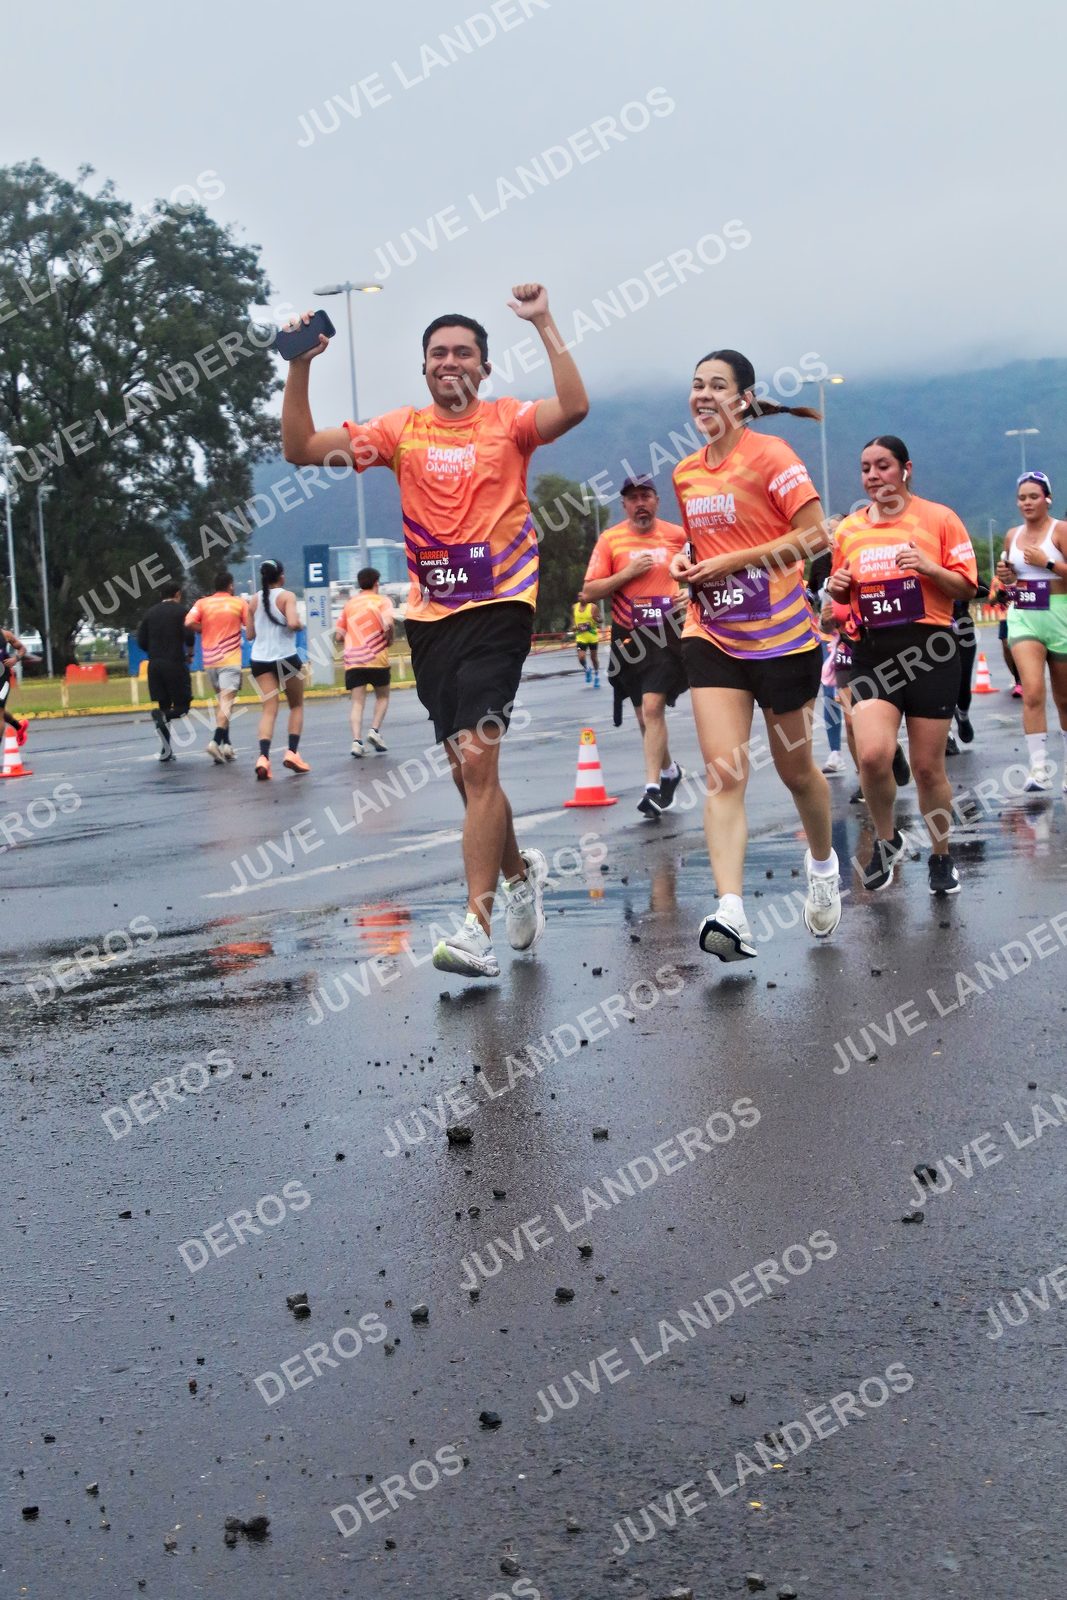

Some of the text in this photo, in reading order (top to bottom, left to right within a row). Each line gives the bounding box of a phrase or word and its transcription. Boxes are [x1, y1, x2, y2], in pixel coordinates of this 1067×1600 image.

[686, 493, 736, 517] CARRERA
[308, 562, 324, 582] E
[434, 568, 468, 585] 344
[713, 588, 744, 606] 345
[642, 608, 662, 618] 798
[872, 598, 902, 615] 341
